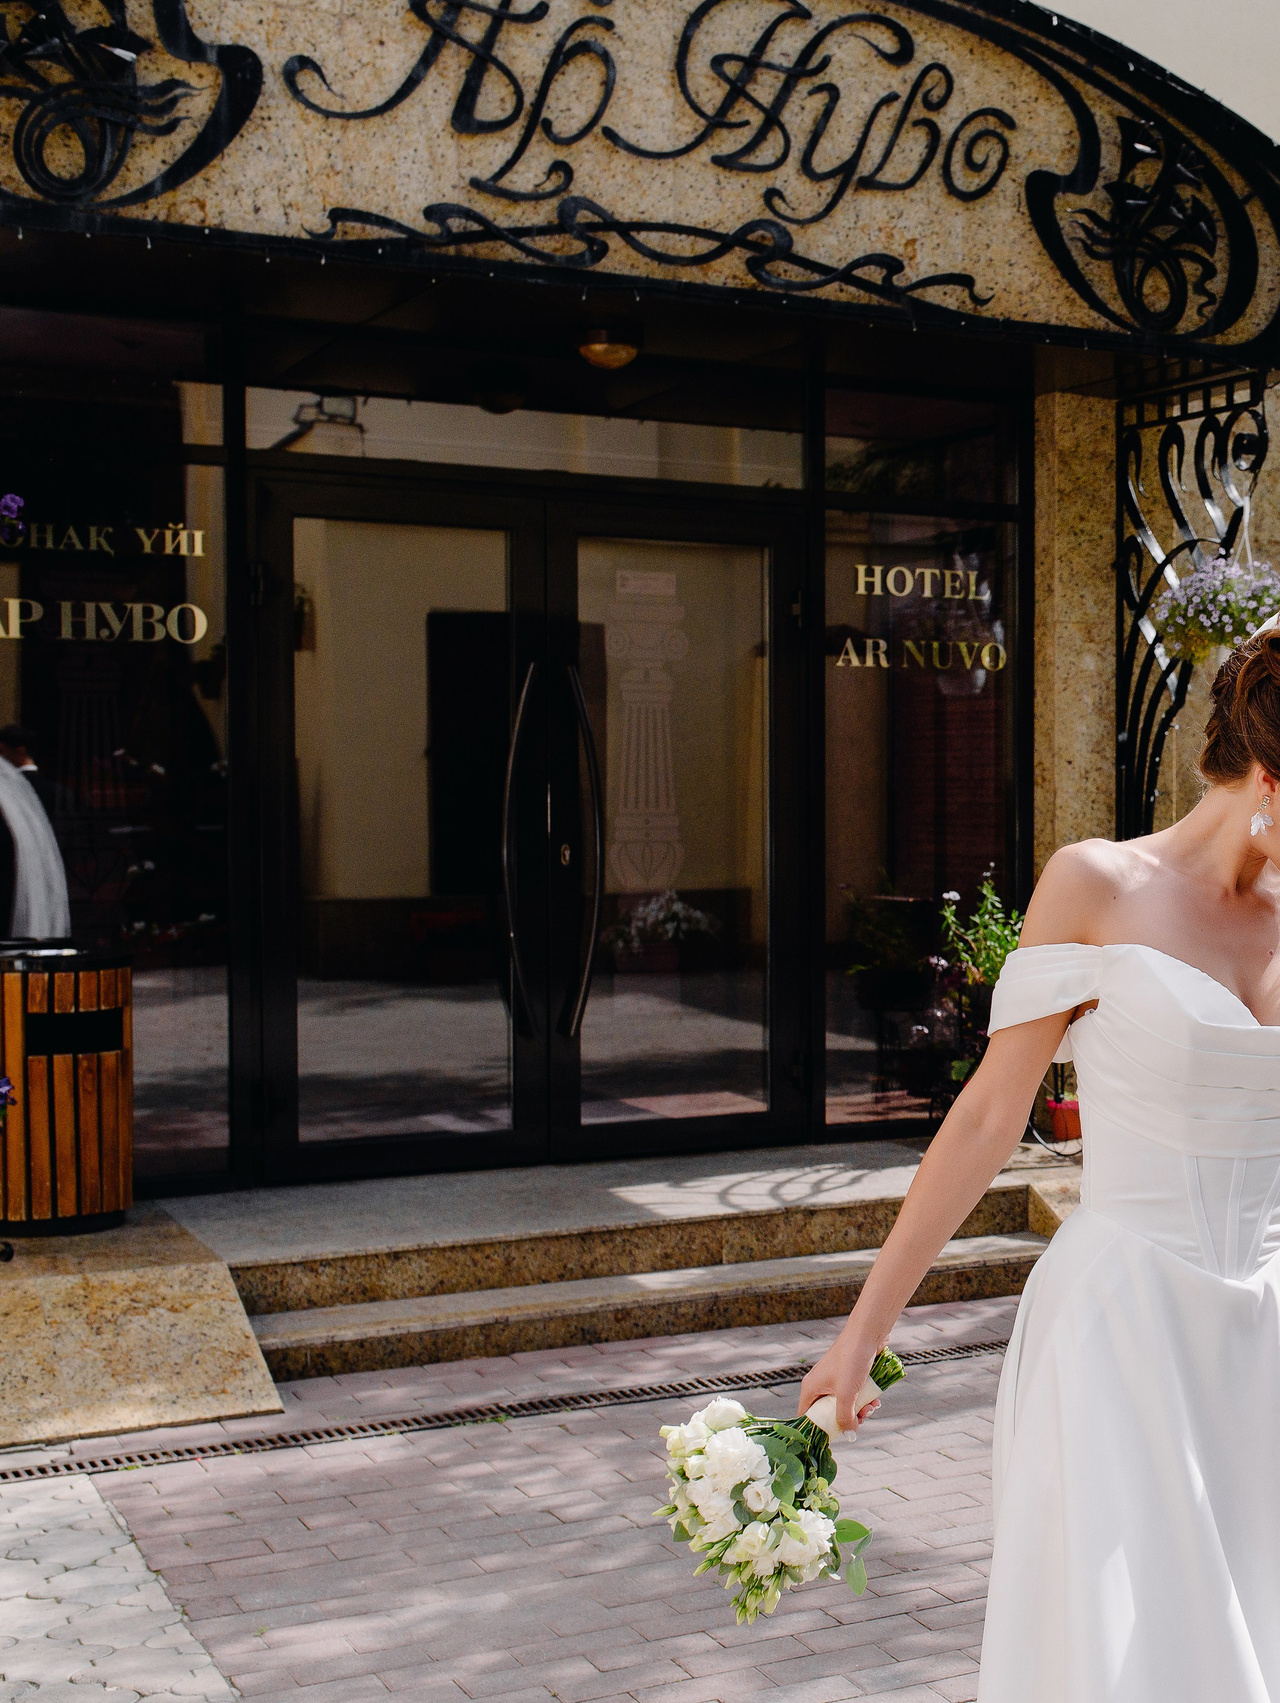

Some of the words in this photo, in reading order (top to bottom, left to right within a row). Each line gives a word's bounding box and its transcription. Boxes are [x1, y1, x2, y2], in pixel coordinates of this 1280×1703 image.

[854, 564, 992, 601] HOTEL
[0, 598, 44, 639] Р
[56, 601, 208, 645] НУВО
[835, 637, 890, 669] AR
[902, 639, 1008, 672] NUVO
